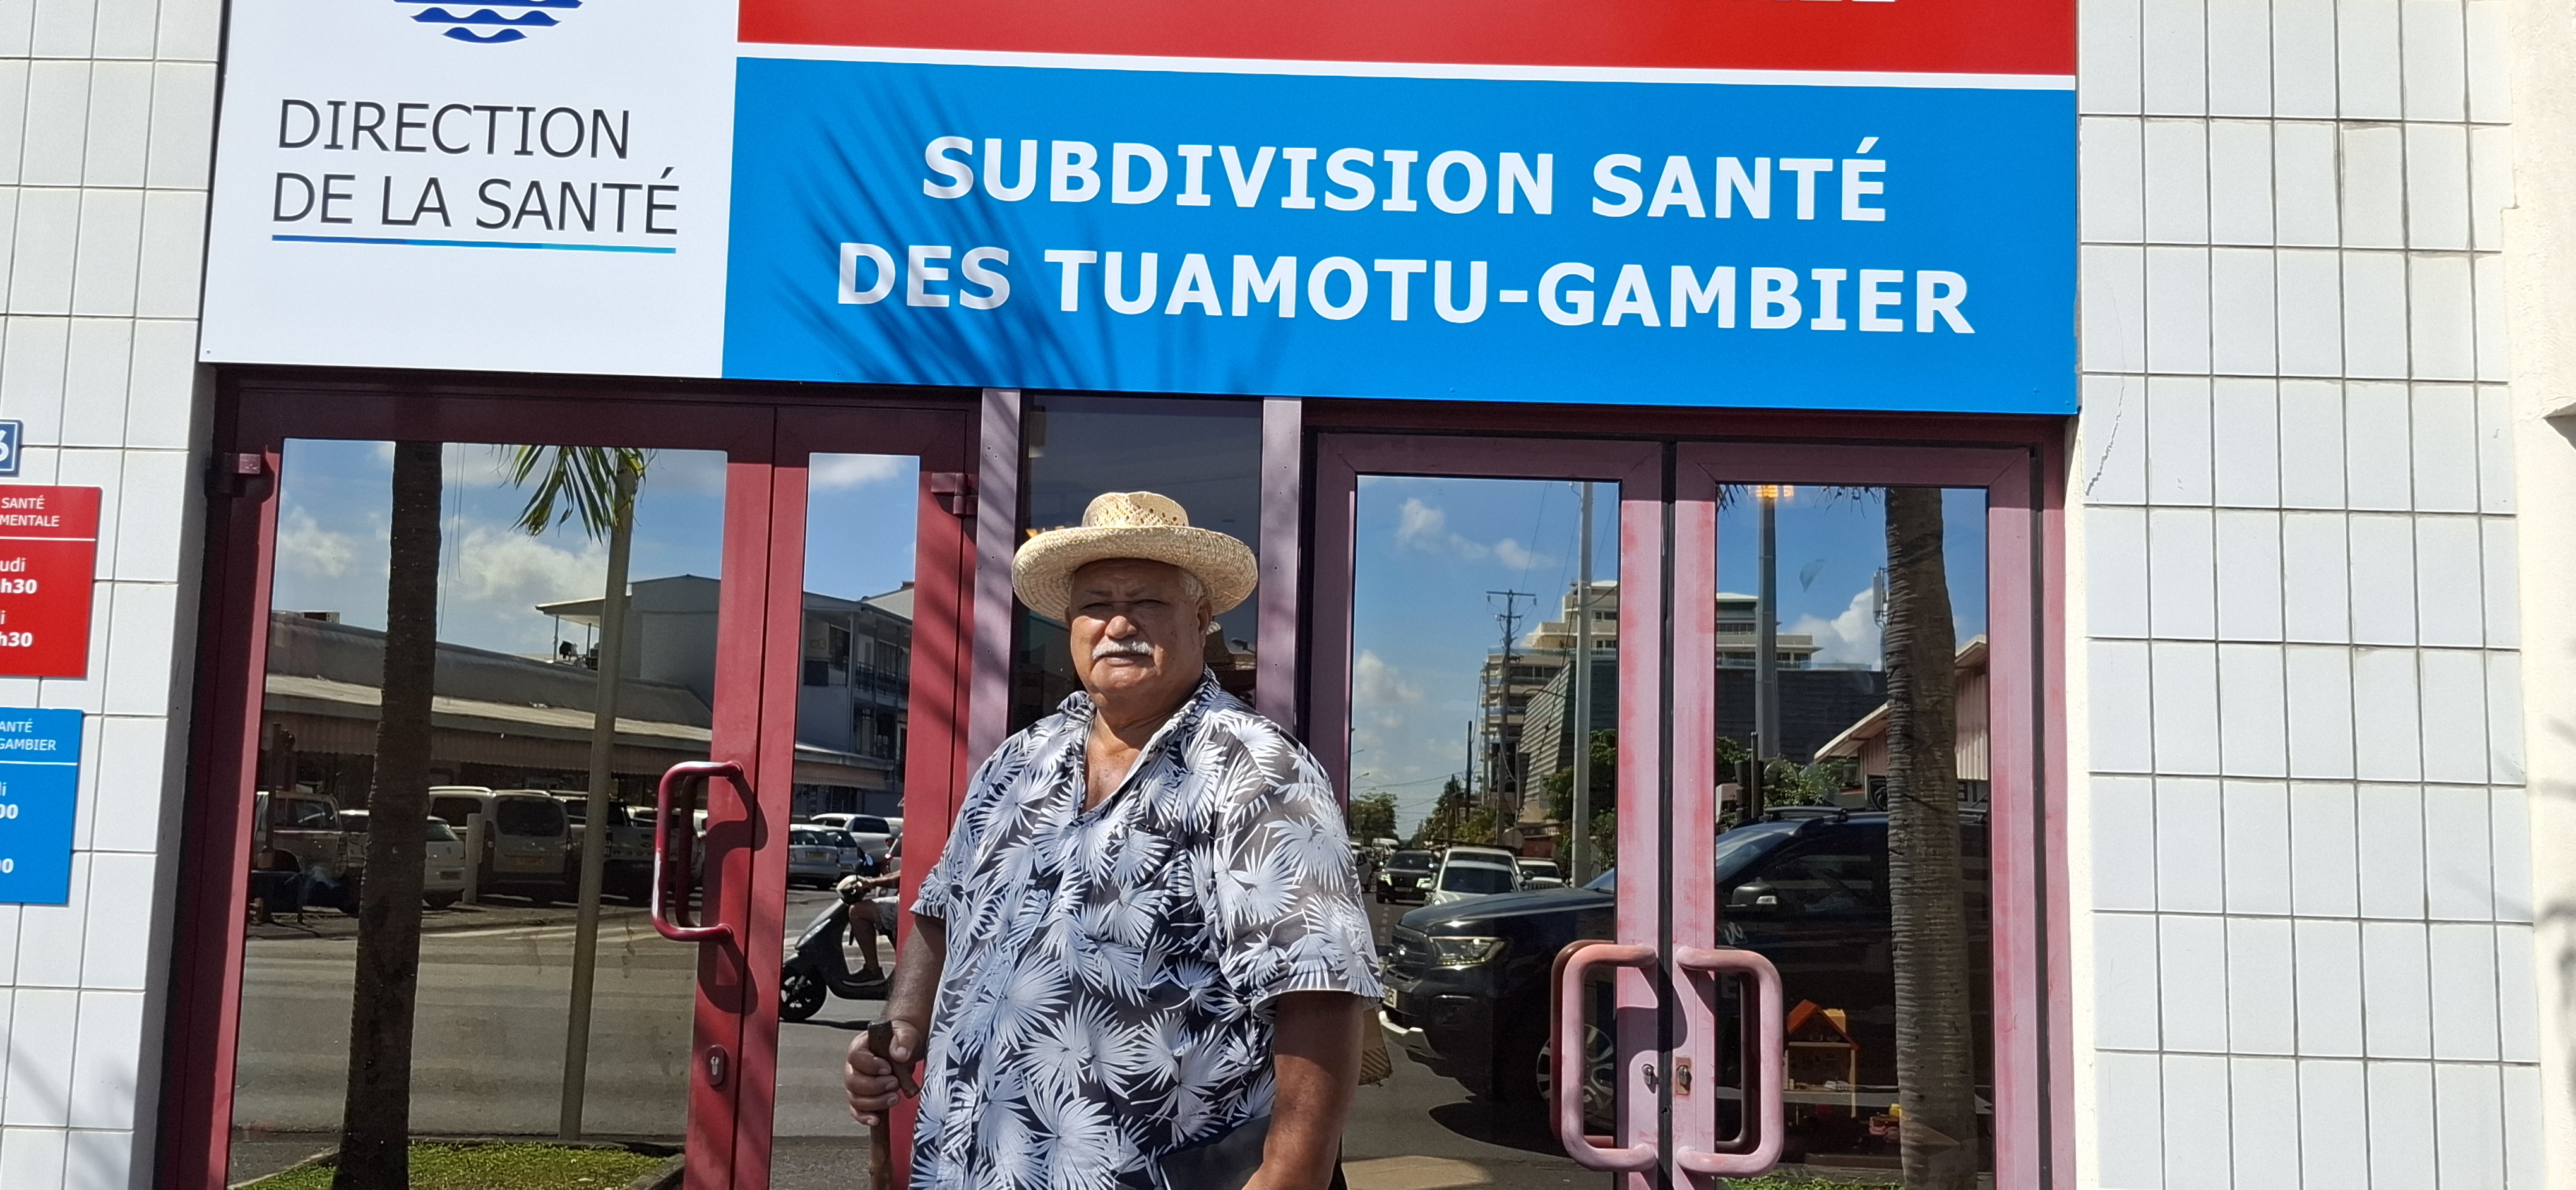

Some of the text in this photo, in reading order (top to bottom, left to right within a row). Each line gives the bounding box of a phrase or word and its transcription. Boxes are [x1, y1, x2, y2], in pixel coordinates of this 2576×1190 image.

[279, 99, 629, 159] DIRECTION
[273, 167, 679, 234] DE LA SANTÉ
[922, 136, 1887, 222] SUBDIVISION SANTÉ
[837, 242, 1975, 334] DES TUAMOTU-GAMBIER
[0, 514, 60, 527] MENTALE
[1, 495, 45, 509] SANTÉ
